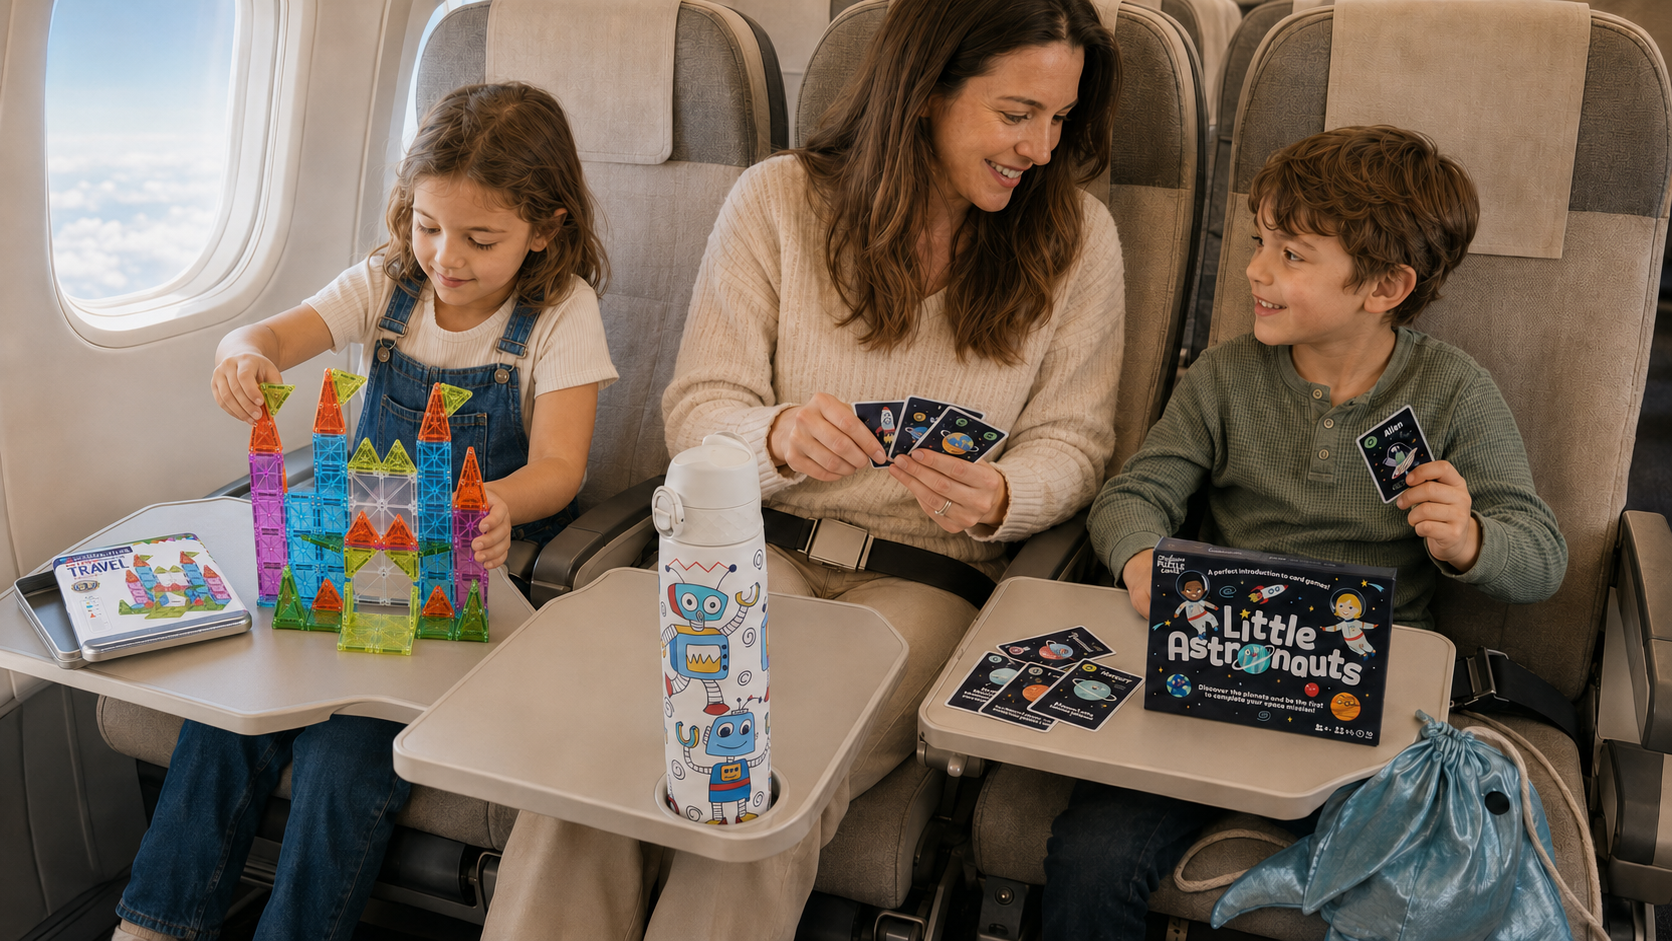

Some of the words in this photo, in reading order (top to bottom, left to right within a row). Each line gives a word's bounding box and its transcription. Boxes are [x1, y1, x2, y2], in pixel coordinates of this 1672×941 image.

[1384, 421, 1404, 438] Alien
[67, 558, 130, 577] TRAVEL
[1214, 568, 1238, 576] perfect
[1239, 568, 1280, 578] introduction
[1289, 575, 1305, 583] card
[1305, 579, 1331, 591] games!
[1223, 605, 1317, 650] Little
[1198, 684, 1229, 694] Discover
[1242, 691, 1269, 702] planets
[1213, 694, 1246, 703] complete
[1286, 705, 1316, 714] mission!
